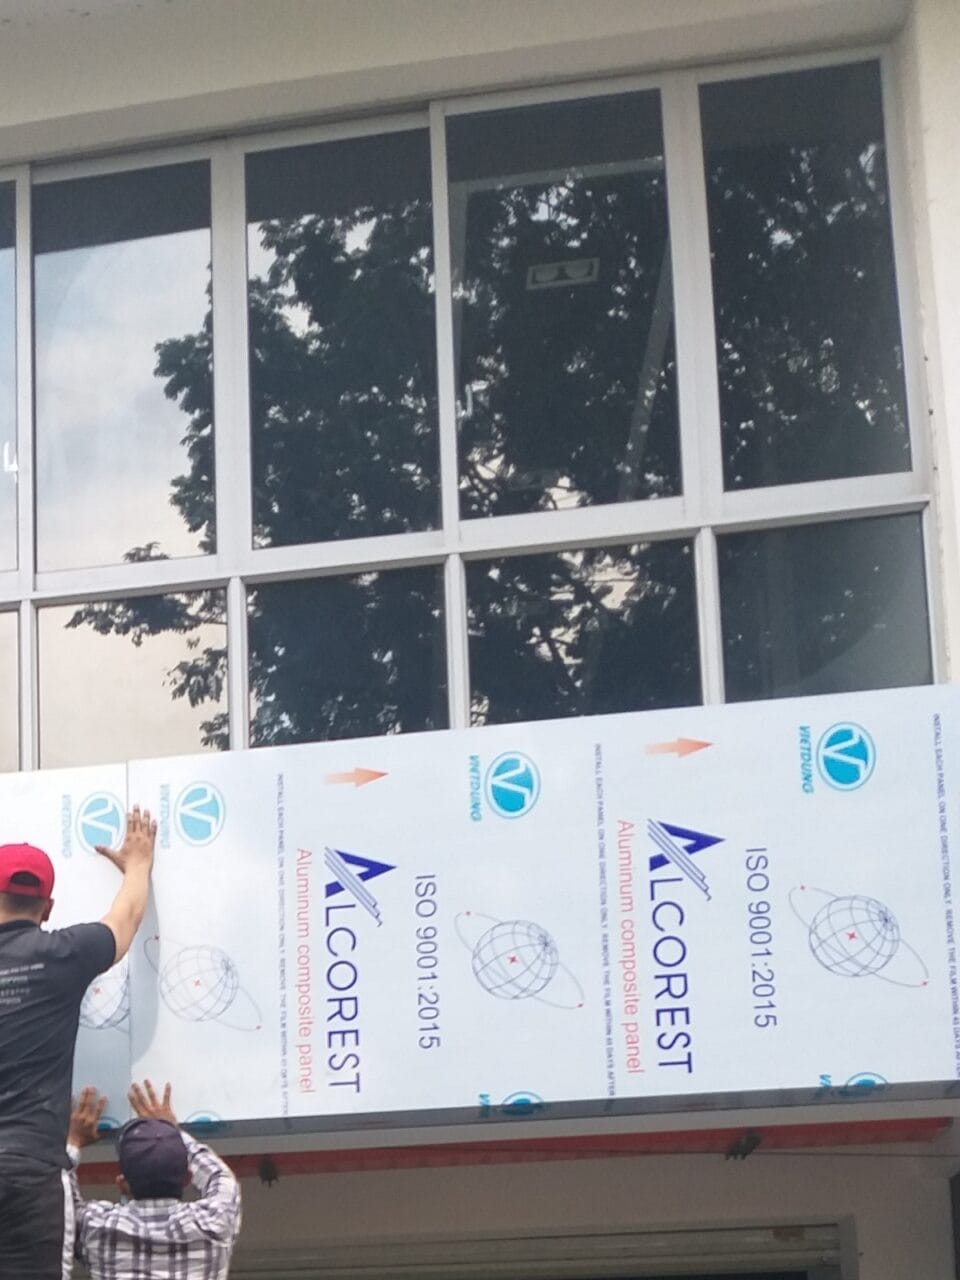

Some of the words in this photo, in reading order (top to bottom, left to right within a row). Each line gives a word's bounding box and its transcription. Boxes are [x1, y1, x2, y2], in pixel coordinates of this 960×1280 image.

[468, 754, 483, 822] VIETDUNG
[798, 724, 814, 794] VIETDUNG
[296, 848, 314, 938] Aluminum
[415, 874, 438, 918] ISO
[616, 820, 636, 912] Aluminum
[746, 847, 771, 892] ISO
[295, 943, 315, 1037] composite
[324, 847, 397, 1093] ALCOREST
[416, 926, 441, 1050] 9001:2015
[617, 918, 640, 1015] composite
[647, 818, 727, 1074] ALCOREST
[747, 900, 778, 1028] 9001:2015
[294, 1043, 315, 1094] panel
[620, 1021, 645, 1074] panel
